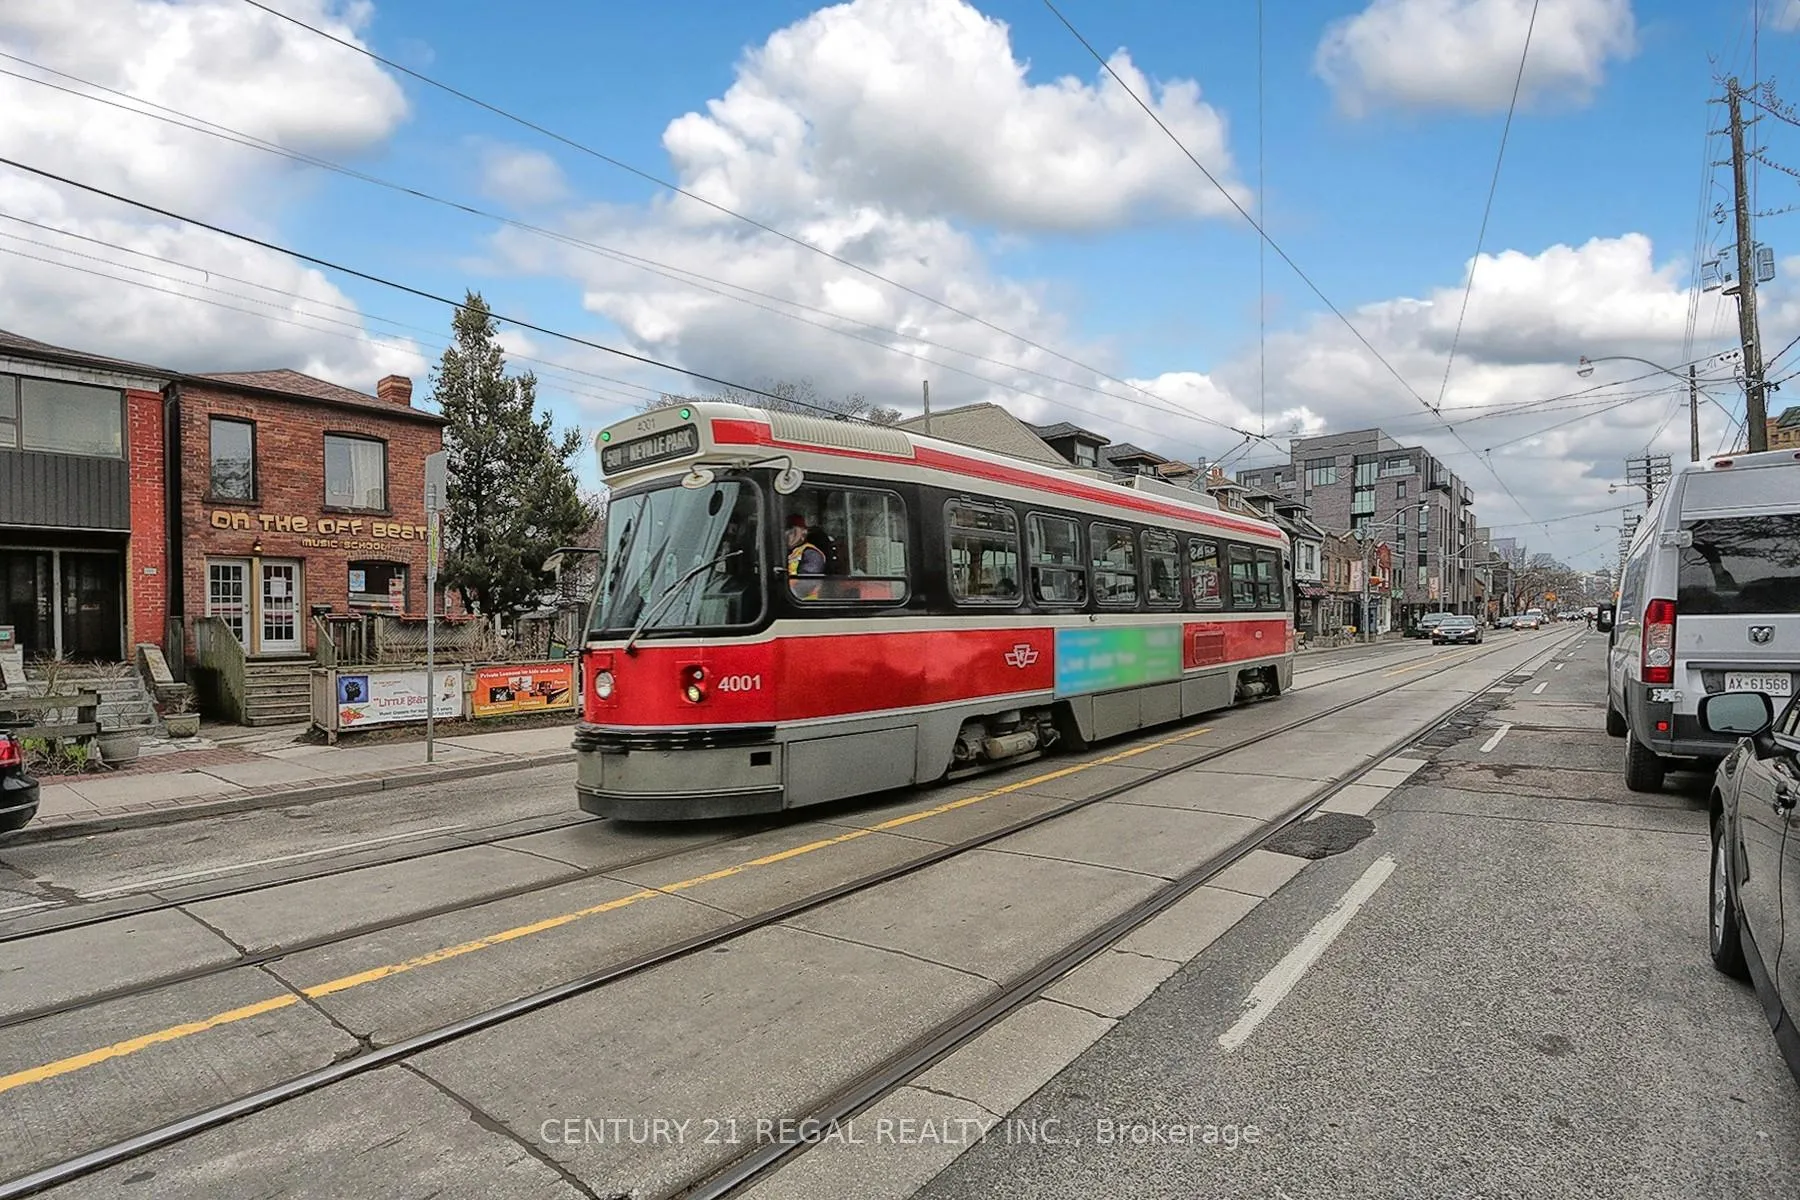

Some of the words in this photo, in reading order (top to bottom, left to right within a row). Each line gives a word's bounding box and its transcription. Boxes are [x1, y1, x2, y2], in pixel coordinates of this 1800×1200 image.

[665, 429, 692, 453] PARK
[317, 518, 363, 536] OFF
[343, 541, 390, 551] SCHOOL
[717, 674, 761, 692] 4001
